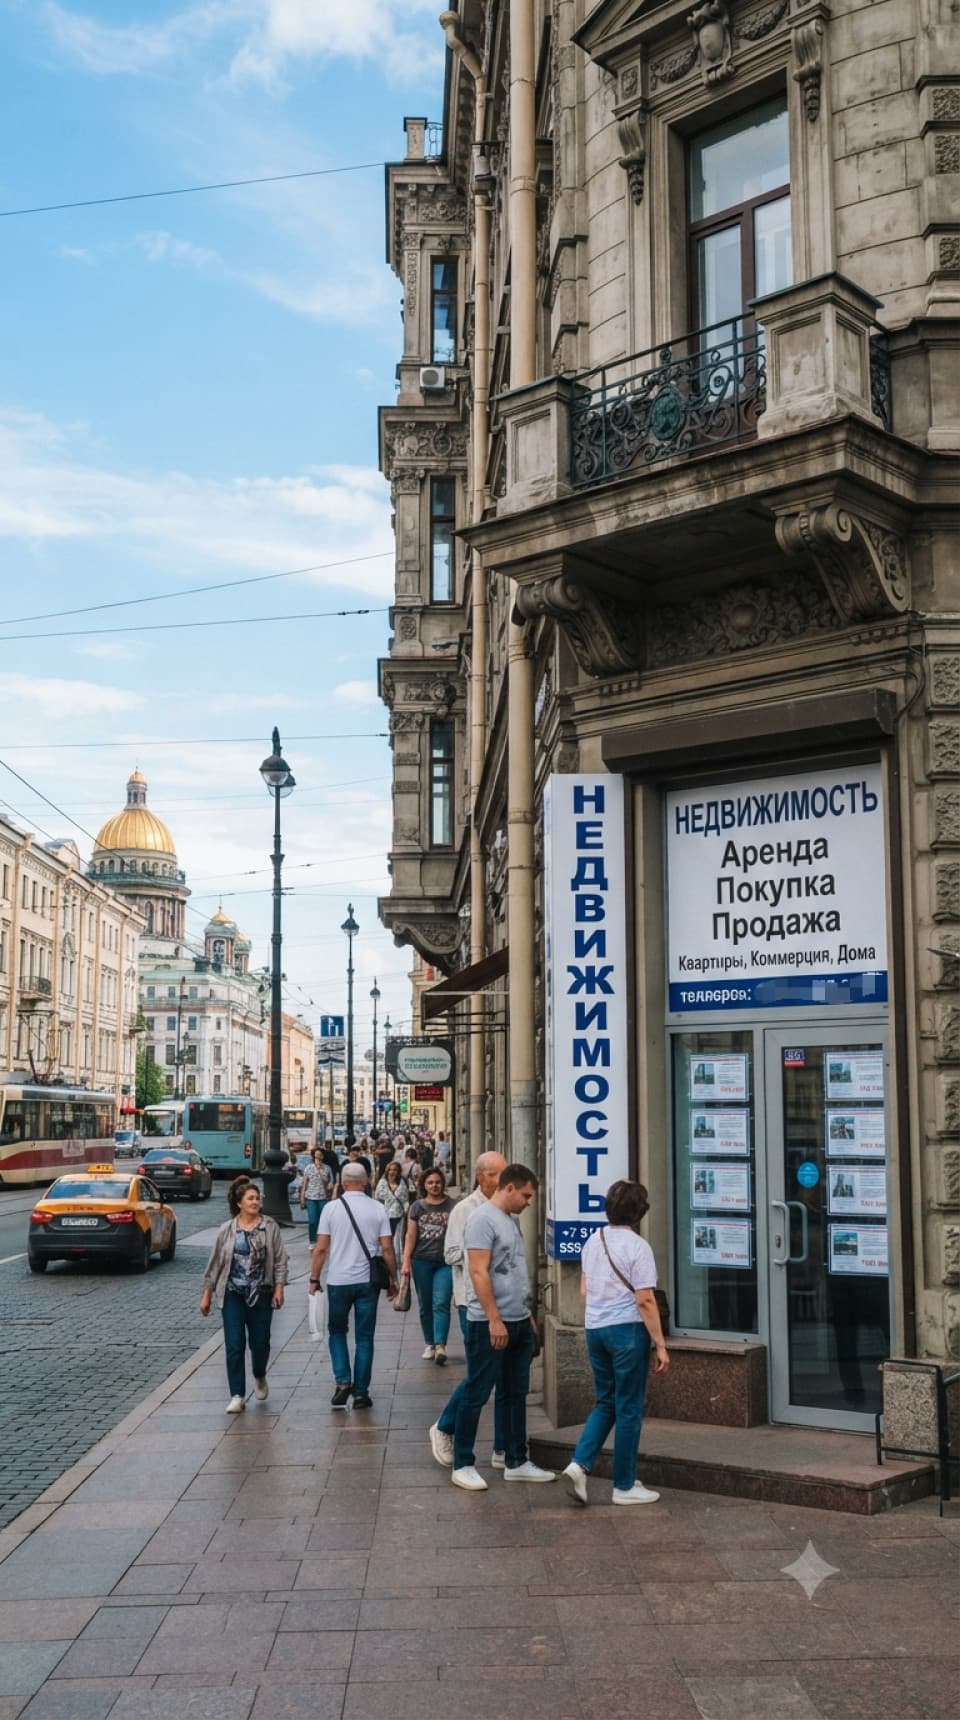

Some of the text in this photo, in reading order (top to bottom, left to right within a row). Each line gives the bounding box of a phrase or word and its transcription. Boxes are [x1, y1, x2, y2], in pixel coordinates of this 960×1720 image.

[675, 781, 878, 837] НЕДВИЖИМОСТЬ
[721, 837, 829, 873] Аренда
[716, 873, 836, 907] Покупка
[712, 910, 841, 945] Продажа
[750, 949, 833, 969] Коммерция,
[837, 944, 876, 965] Дома
[566, 785, 615, 1213] НЕДВИЖИМОСТЬ
